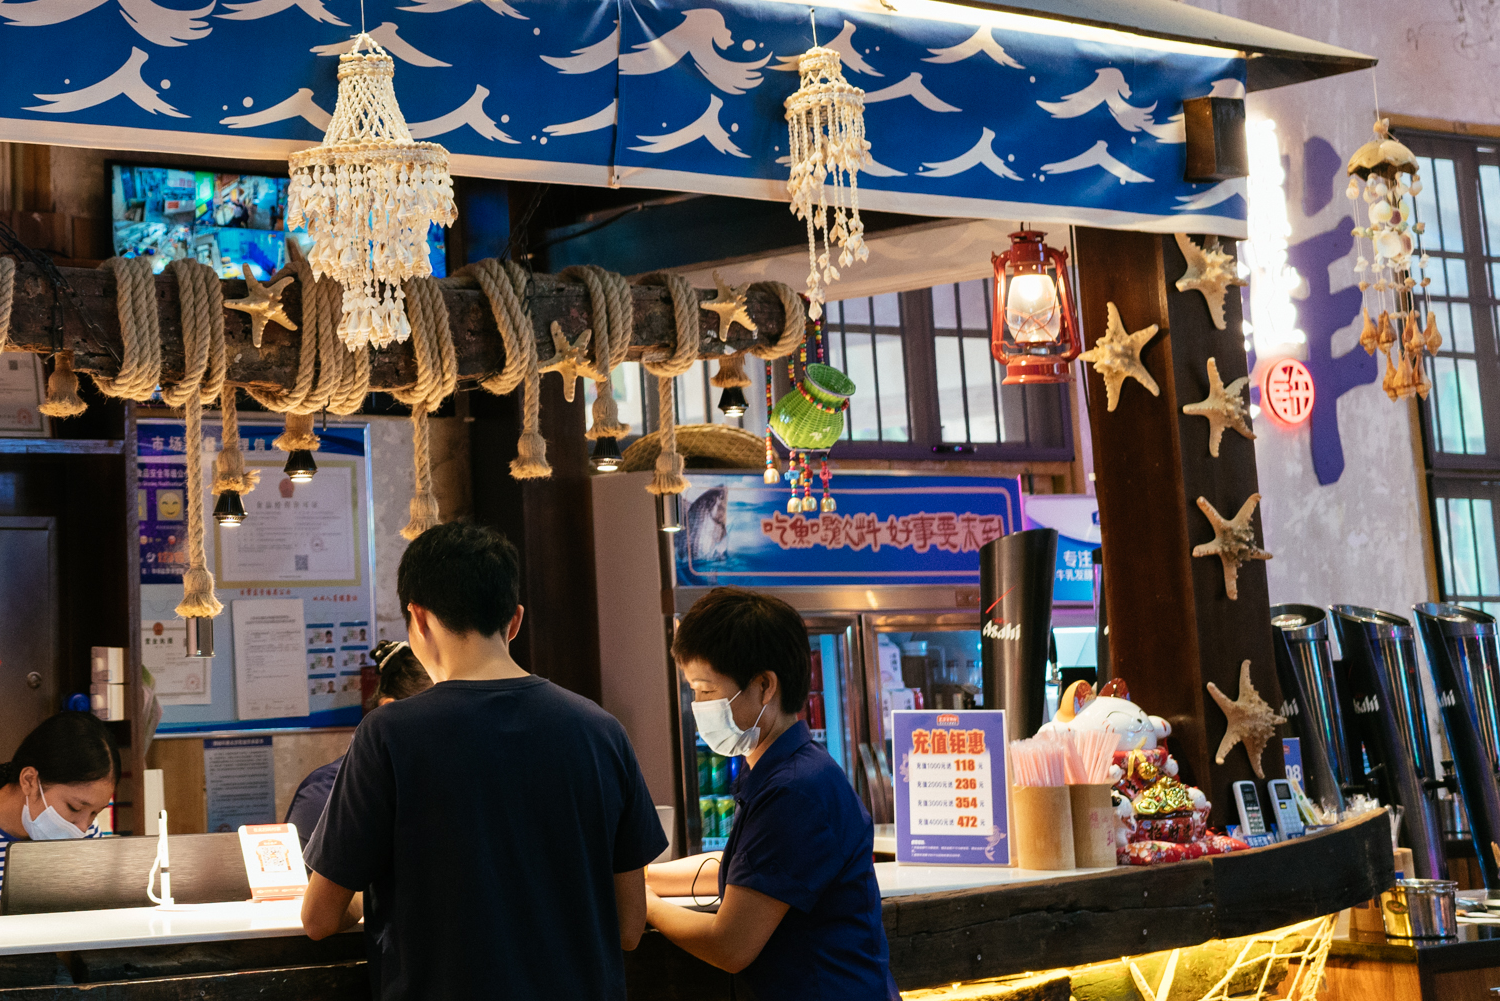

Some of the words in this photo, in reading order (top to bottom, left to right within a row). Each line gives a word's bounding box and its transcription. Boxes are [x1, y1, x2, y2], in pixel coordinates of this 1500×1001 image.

[983, 620, 1021, 641] Asahi
[912, 729, 985, 755] 充值钜惠
[954, 759, 975, 771] 118
[955, 778, 977, 790] 236
[955, 797, 978, 808] 354
[957, 816, 978, 827] 472
